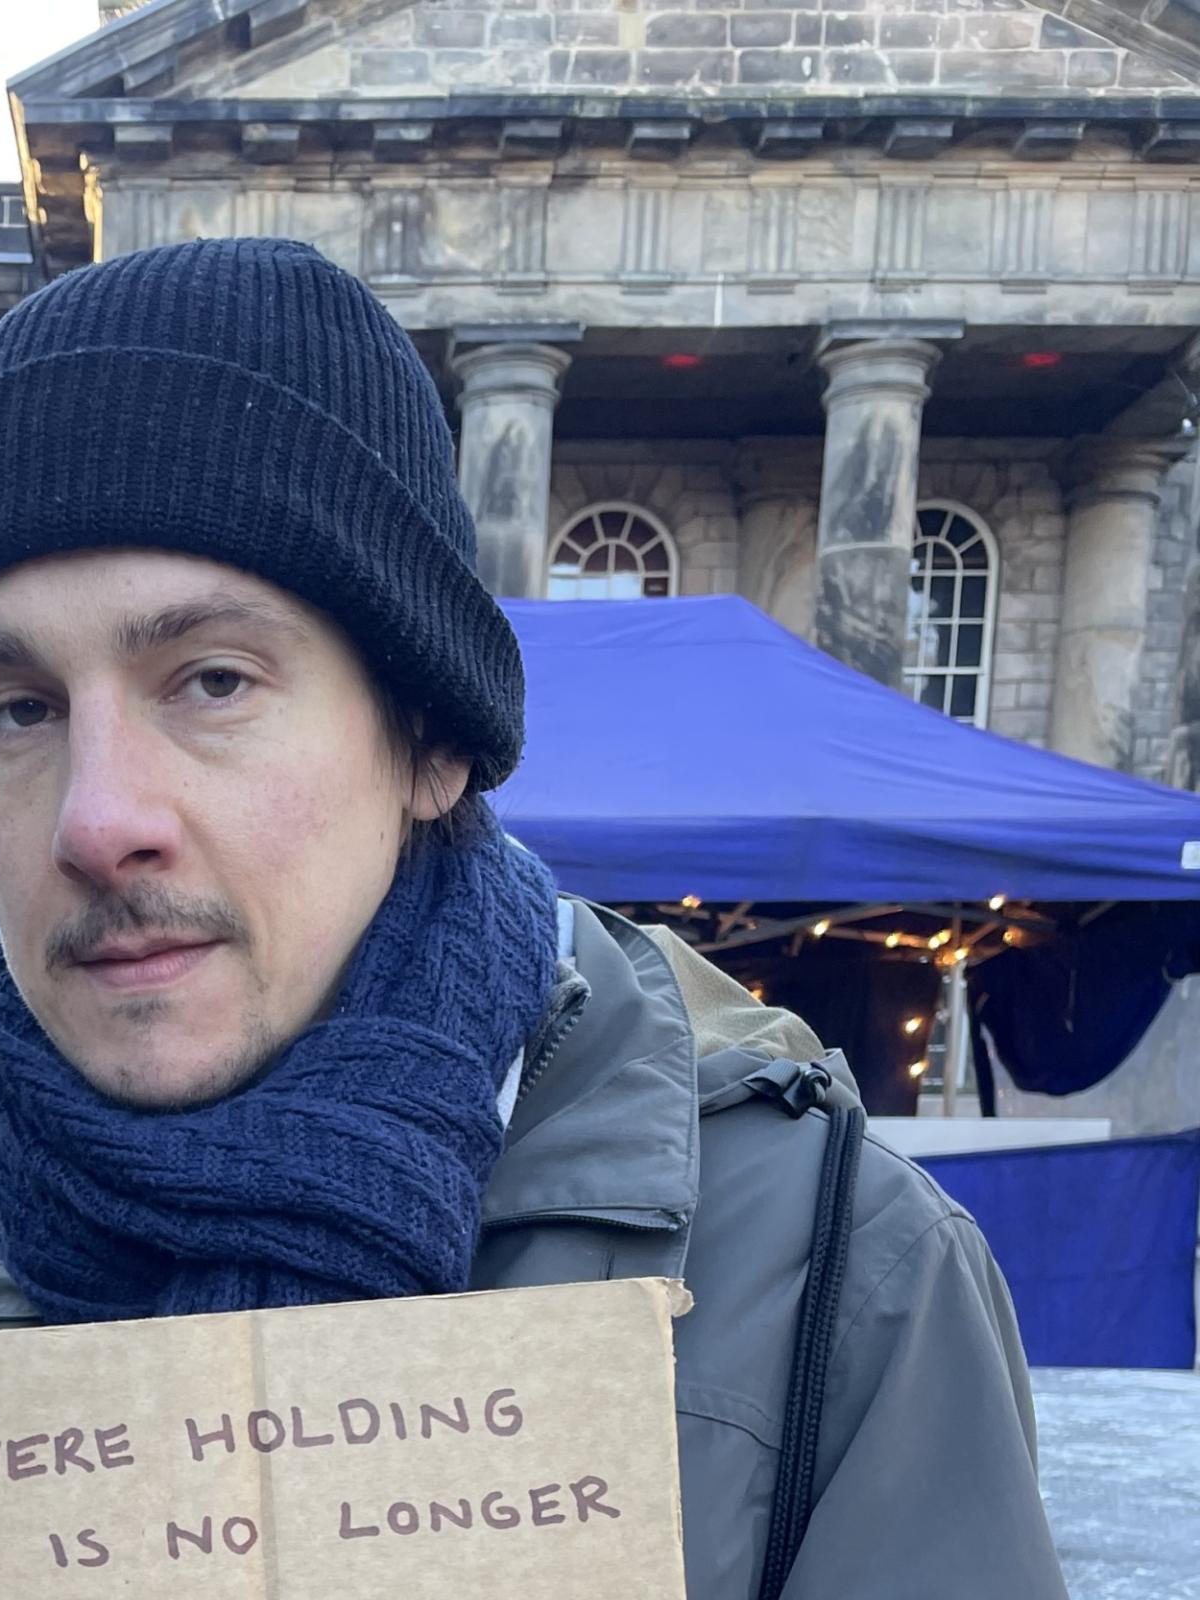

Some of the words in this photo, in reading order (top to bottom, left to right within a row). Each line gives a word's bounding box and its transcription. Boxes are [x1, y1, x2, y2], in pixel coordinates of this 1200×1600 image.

[184, 1388, 523, 1462] HOLDING
[48, 1528, 110, 1568] IS
[166, 1515, 258, 1560] NO
[338, 1475, 621, 1540] LONGER
